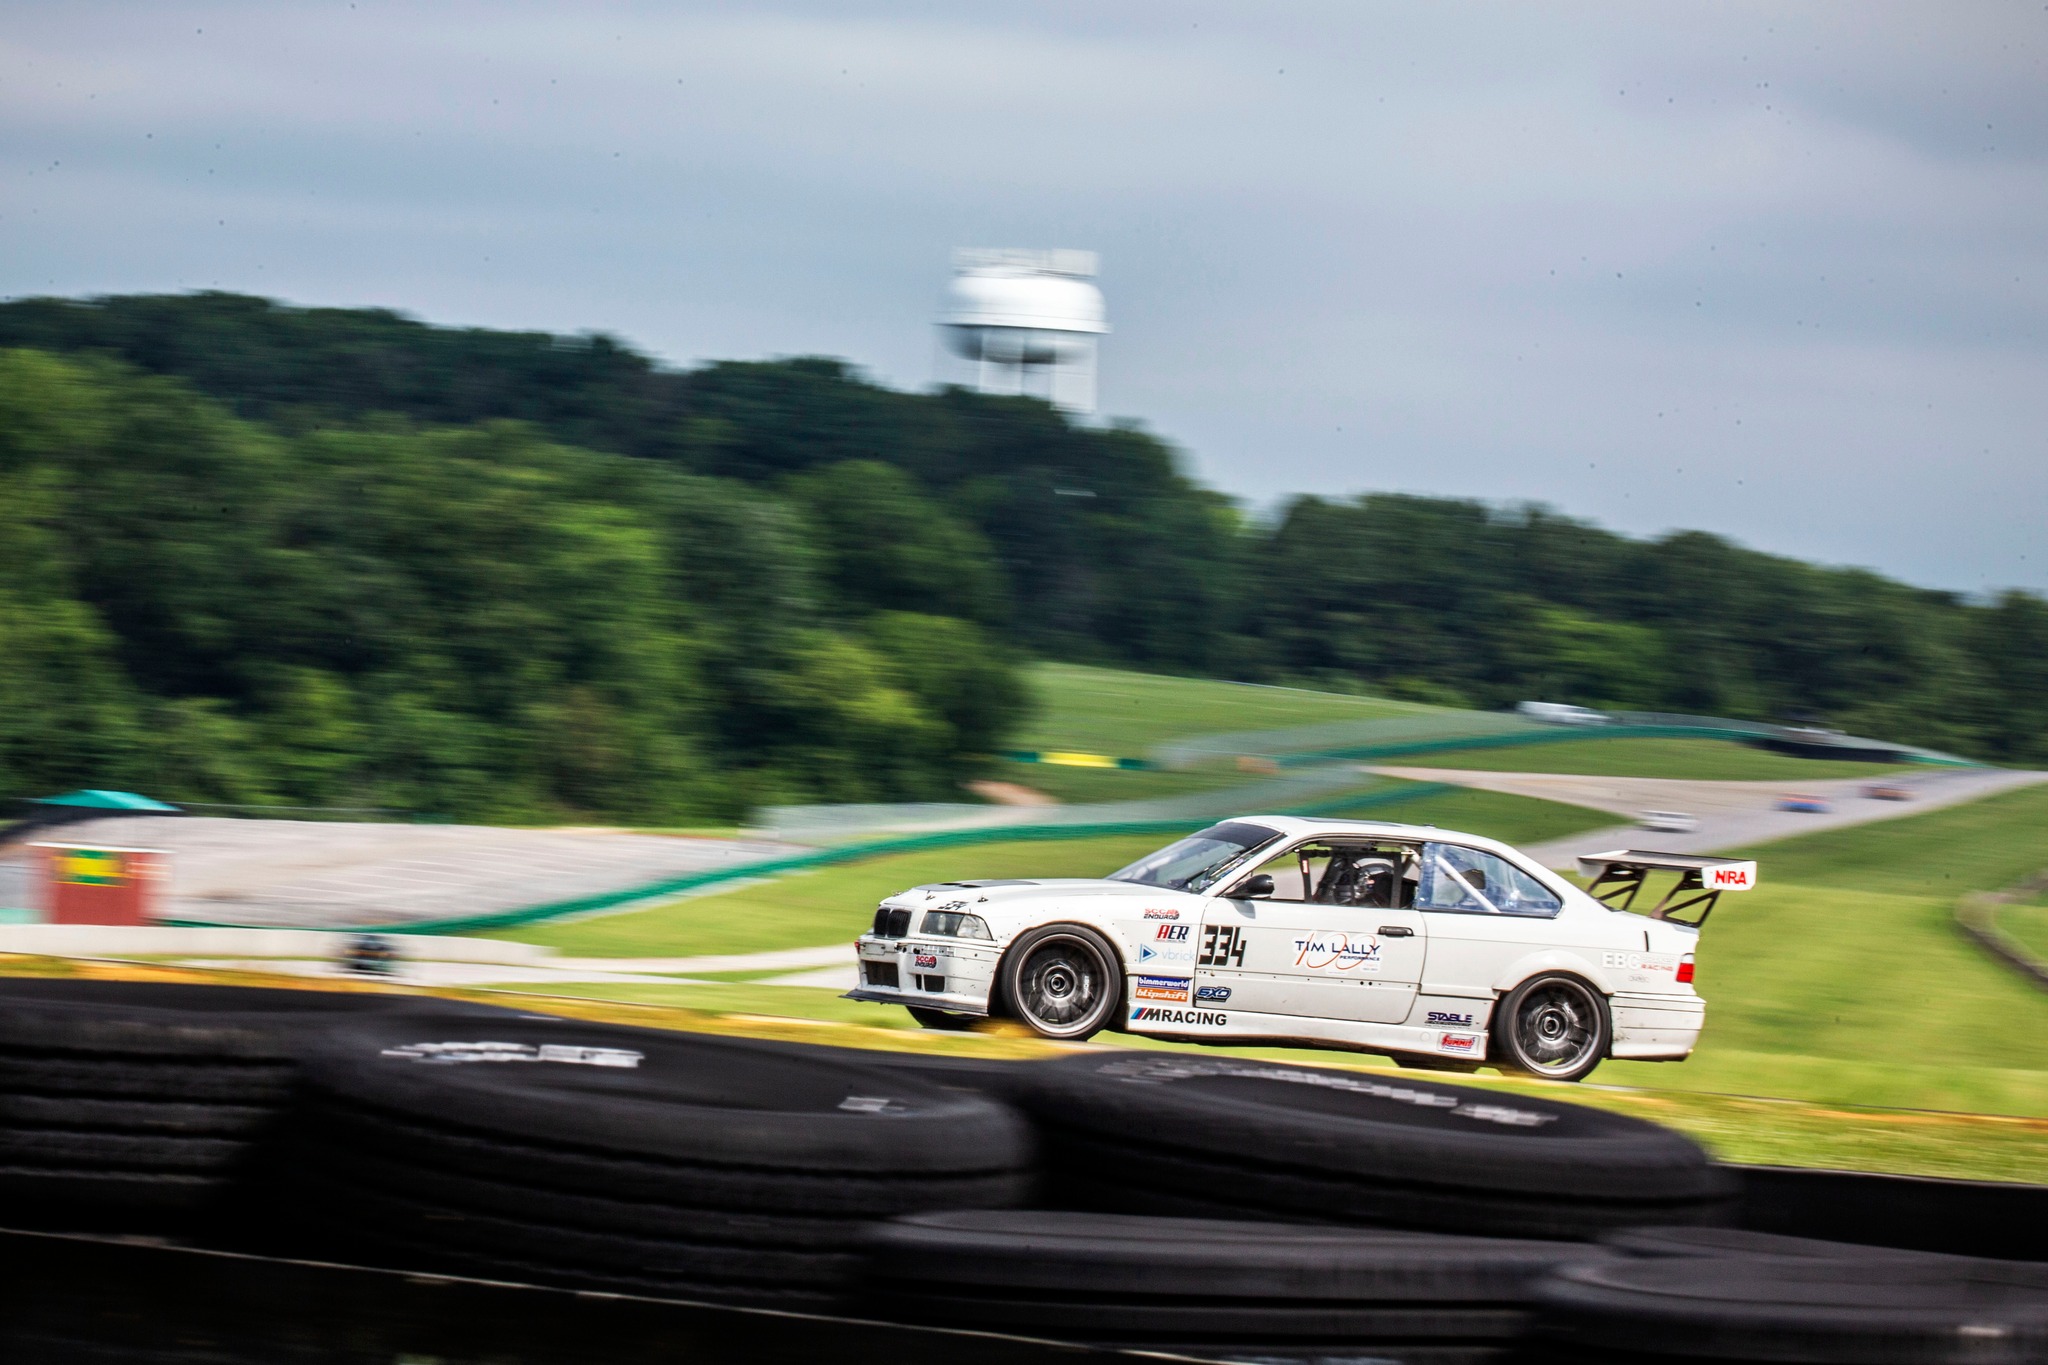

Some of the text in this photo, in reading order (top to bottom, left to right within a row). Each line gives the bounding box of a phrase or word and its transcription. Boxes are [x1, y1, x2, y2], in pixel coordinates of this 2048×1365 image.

[1156, 924, 1190, 940] AER
[1198, 924, 1247, 967] 334
[1295, 941, 1381, 956] TIM LALLY
[1161, 948, 1196, 962] vbrick
[1602, 951, 1640, 970] EBC
[1138, 977, 1189, 988] bimmerworld
[1427, 1011, 1473, 1023] STABLE
